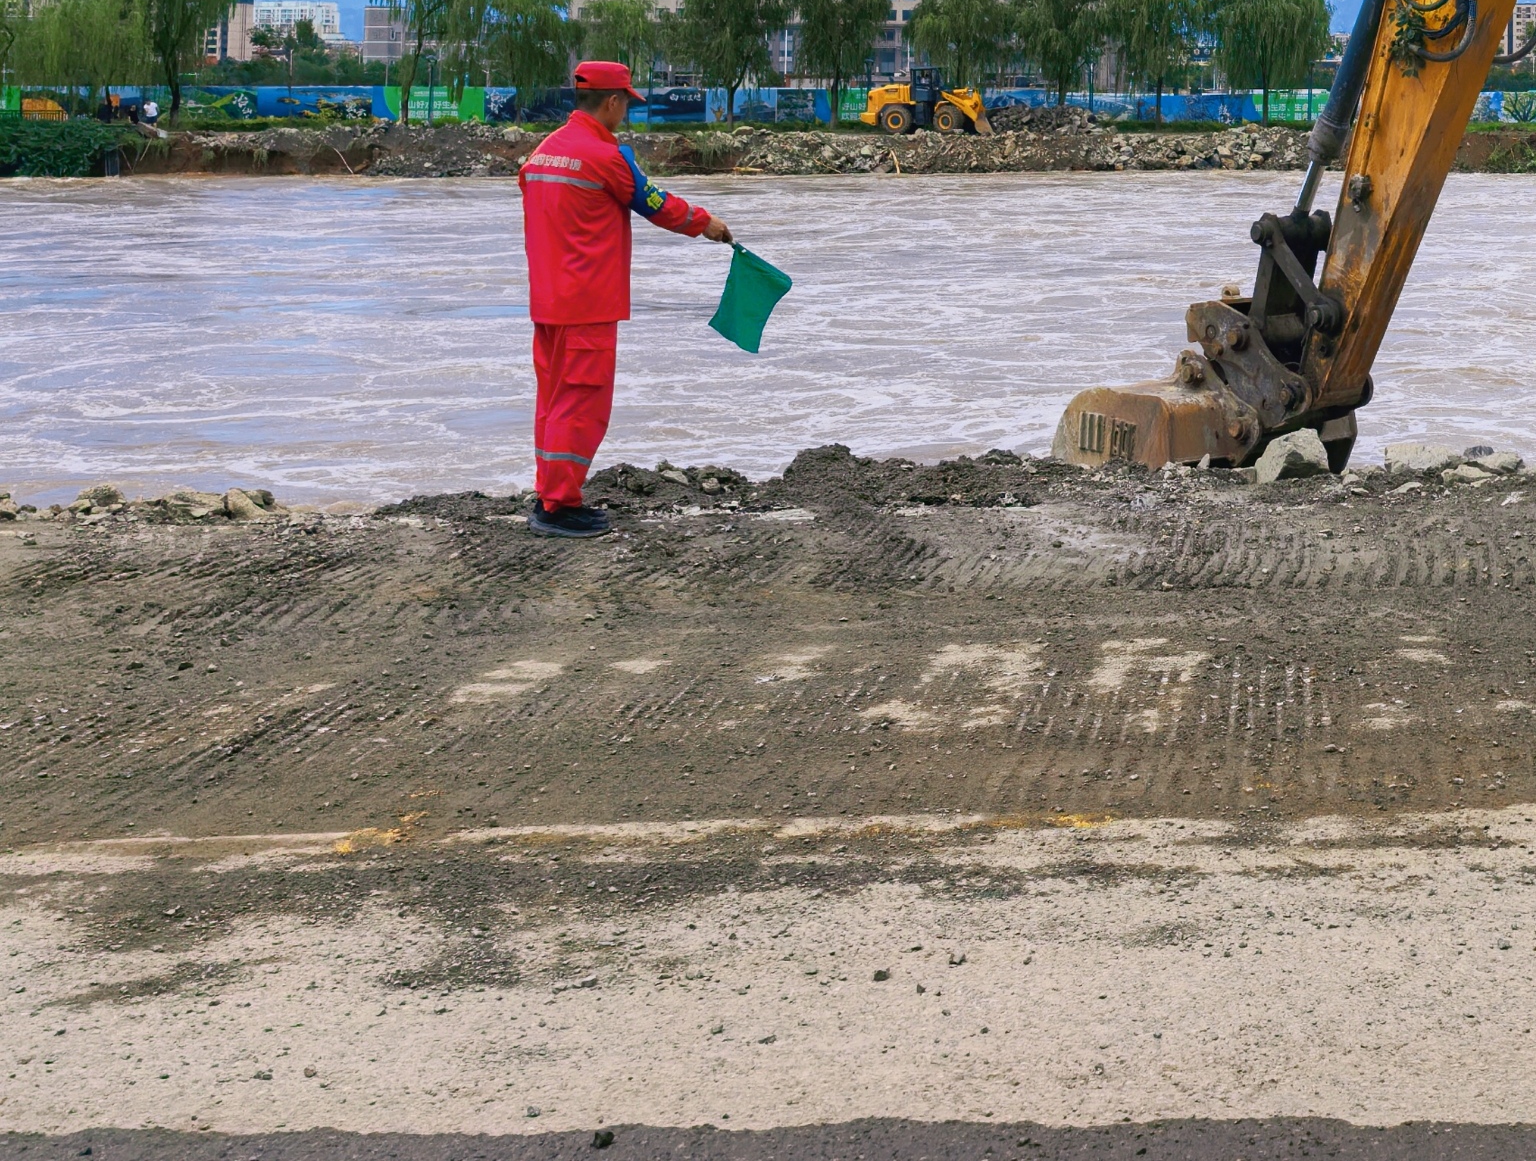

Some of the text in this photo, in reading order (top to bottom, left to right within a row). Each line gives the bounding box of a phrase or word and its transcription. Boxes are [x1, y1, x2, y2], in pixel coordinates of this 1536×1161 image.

[399, 100, 458, 109] 山好好生态
